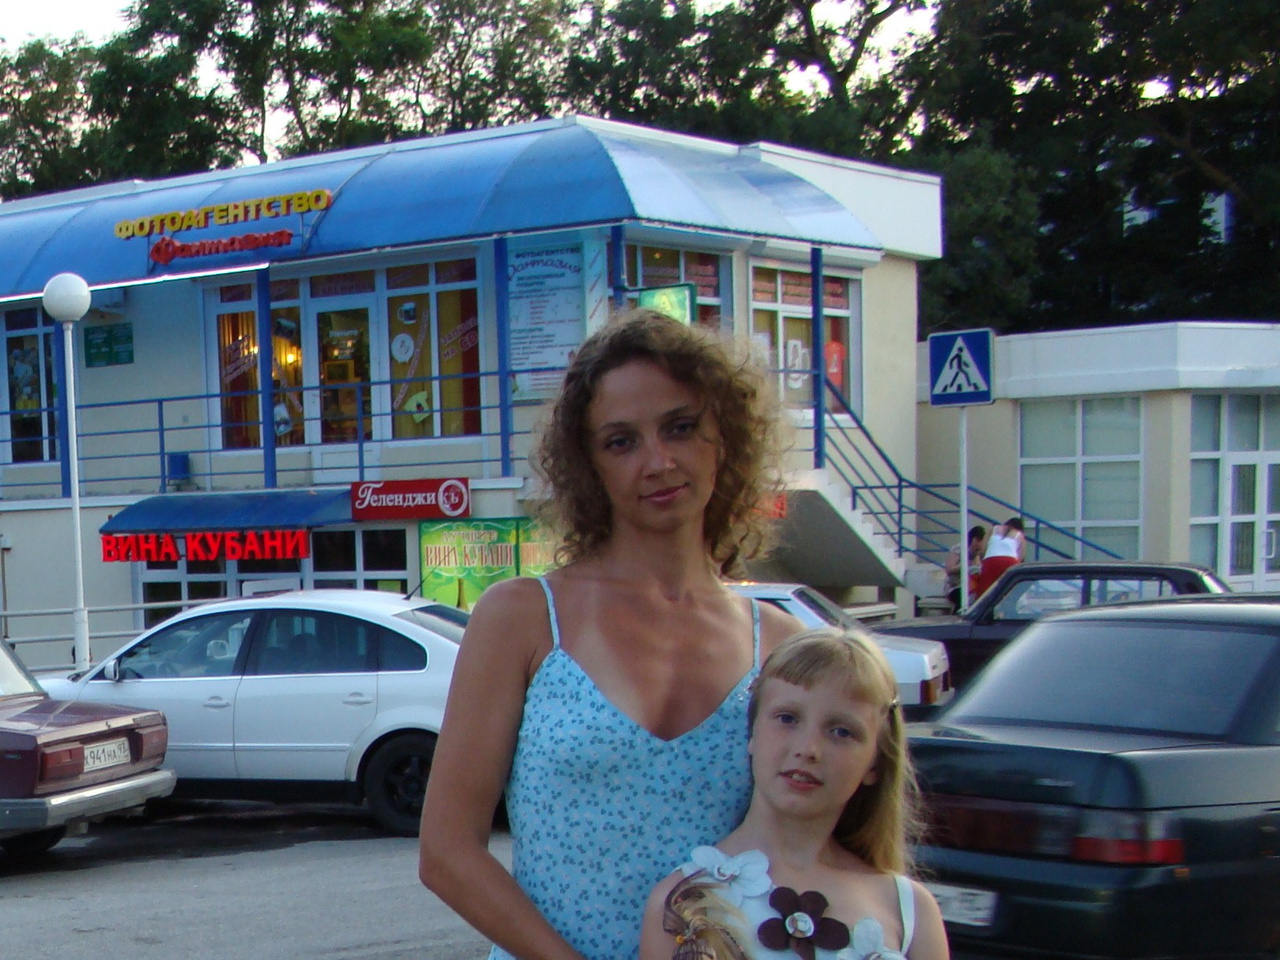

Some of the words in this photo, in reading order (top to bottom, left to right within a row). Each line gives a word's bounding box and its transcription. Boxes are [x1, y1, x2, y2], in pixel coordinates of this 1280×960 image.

[115, 190, 332, 239] ФОТОАГЕНТСТВО
[101, 534, 180, 562] ВИНА
[184, 530, 310, 560] КУБАНИ
[426, 544, 458, 566] ВИНА
[464, 543, 514, 566] КУБАНИ
